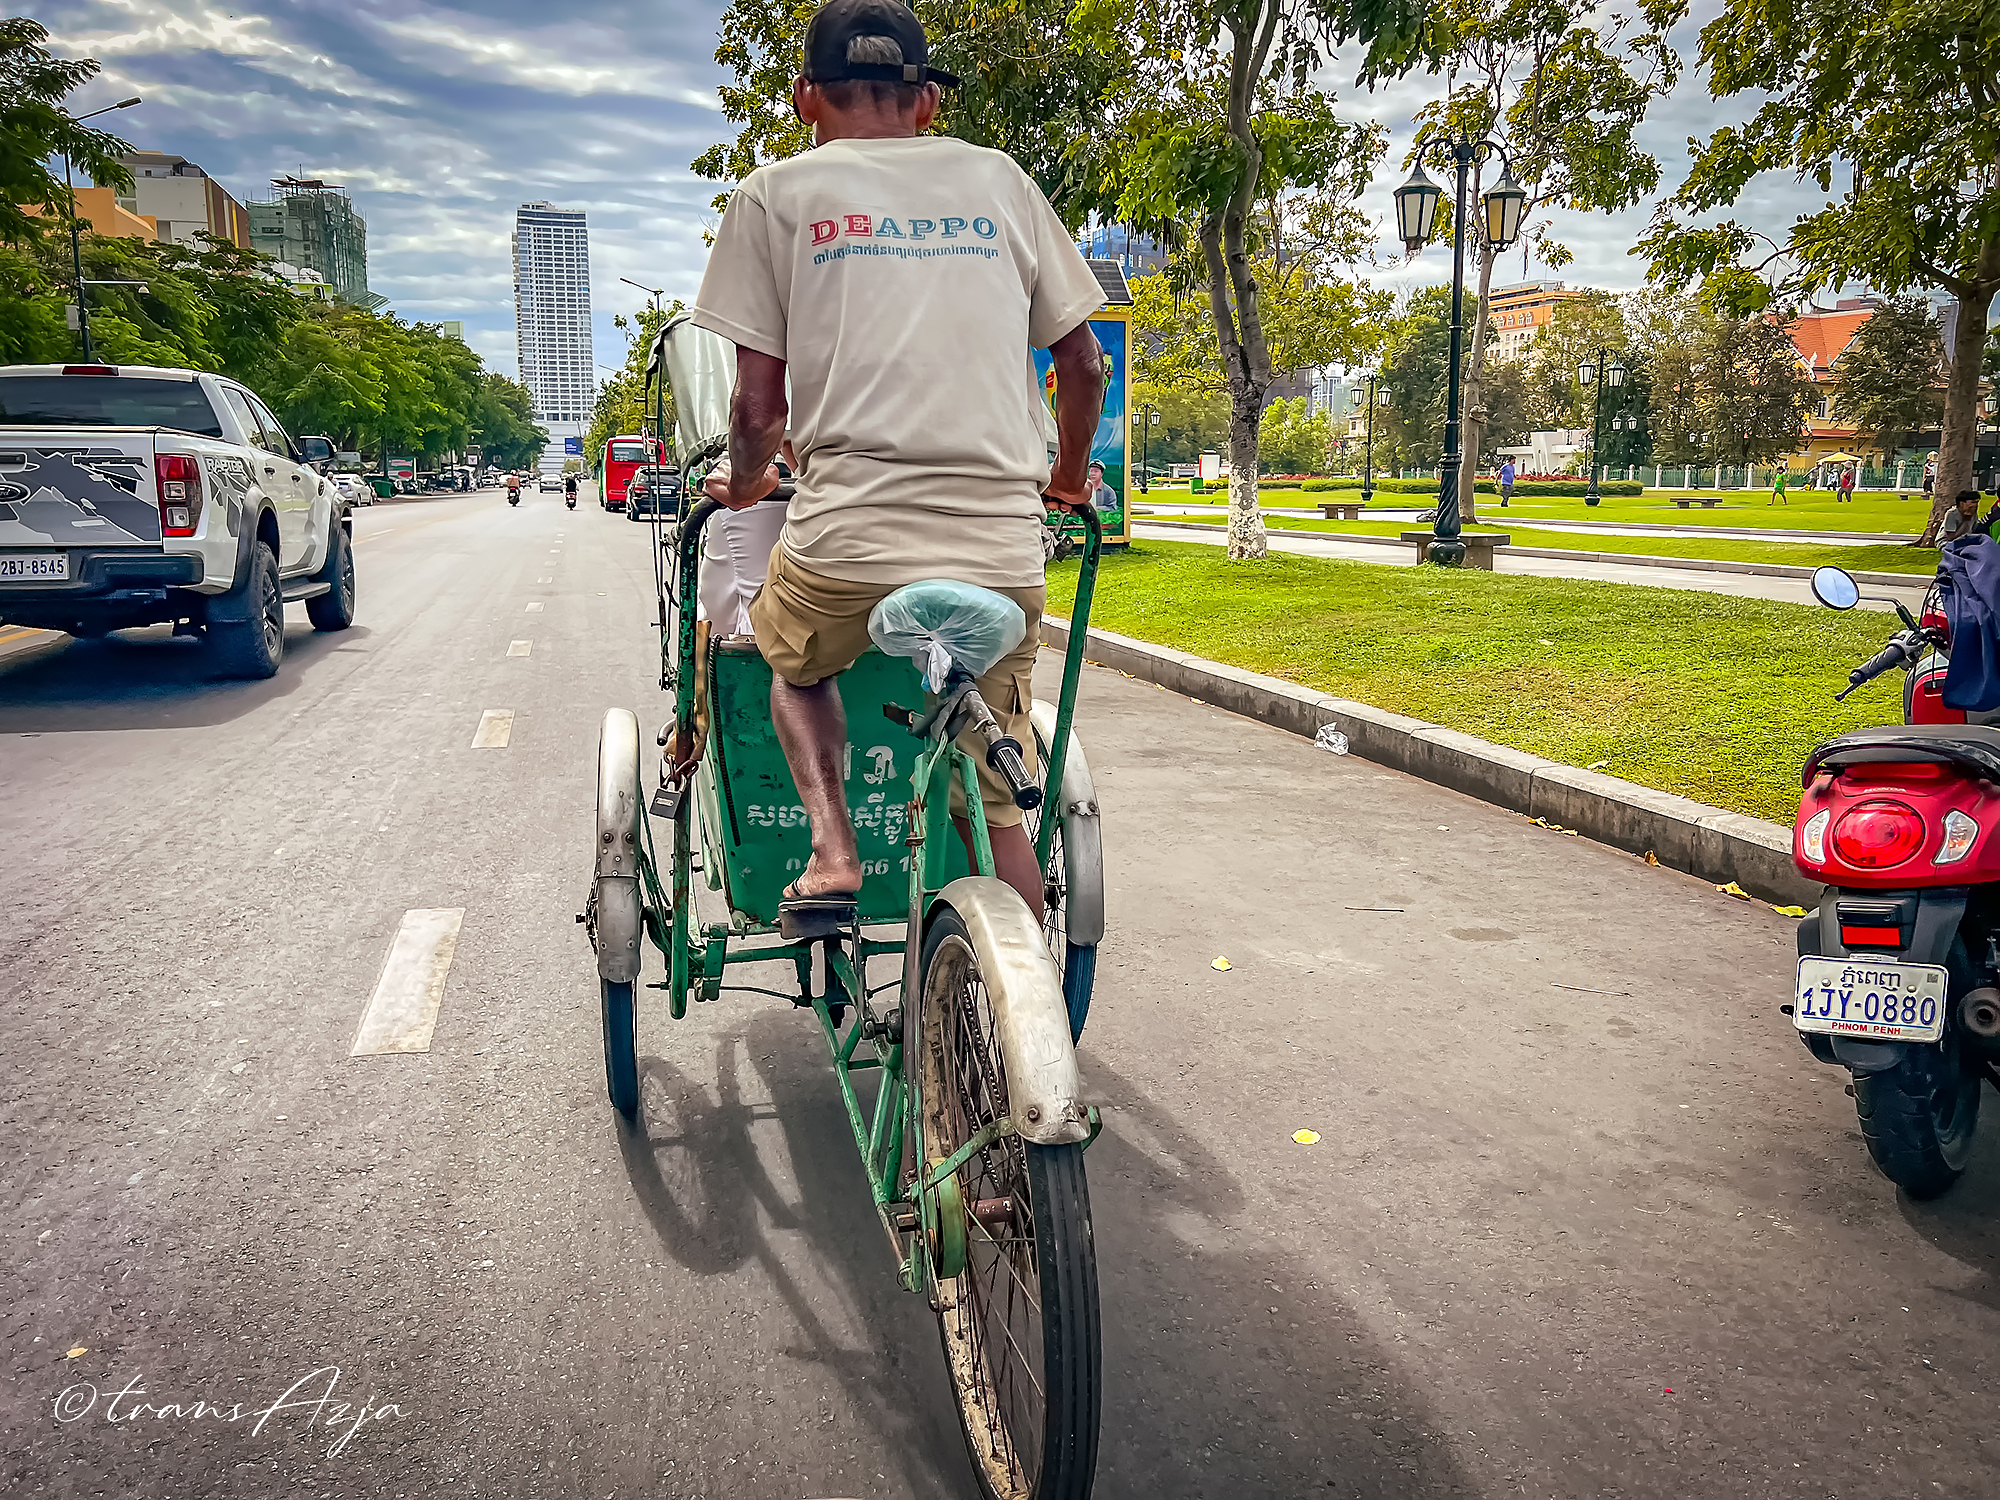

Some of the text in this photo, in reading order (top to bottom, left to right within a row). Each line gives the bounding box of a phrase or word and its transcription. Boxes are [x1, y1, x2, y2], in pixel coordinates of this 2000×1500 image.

[809, 214, 998, 247] DEAPPO
[205, 458, 244, 474] RAPTOR
[0, 559, 65, 576] 2BJ-8545
[1840, 966, 1901, 991] ភ្នំពេញ
[1801, 987, 1936, 1026] 1JY-0880
[1831, 1021, 1901, 1035] PHNOM PENH
